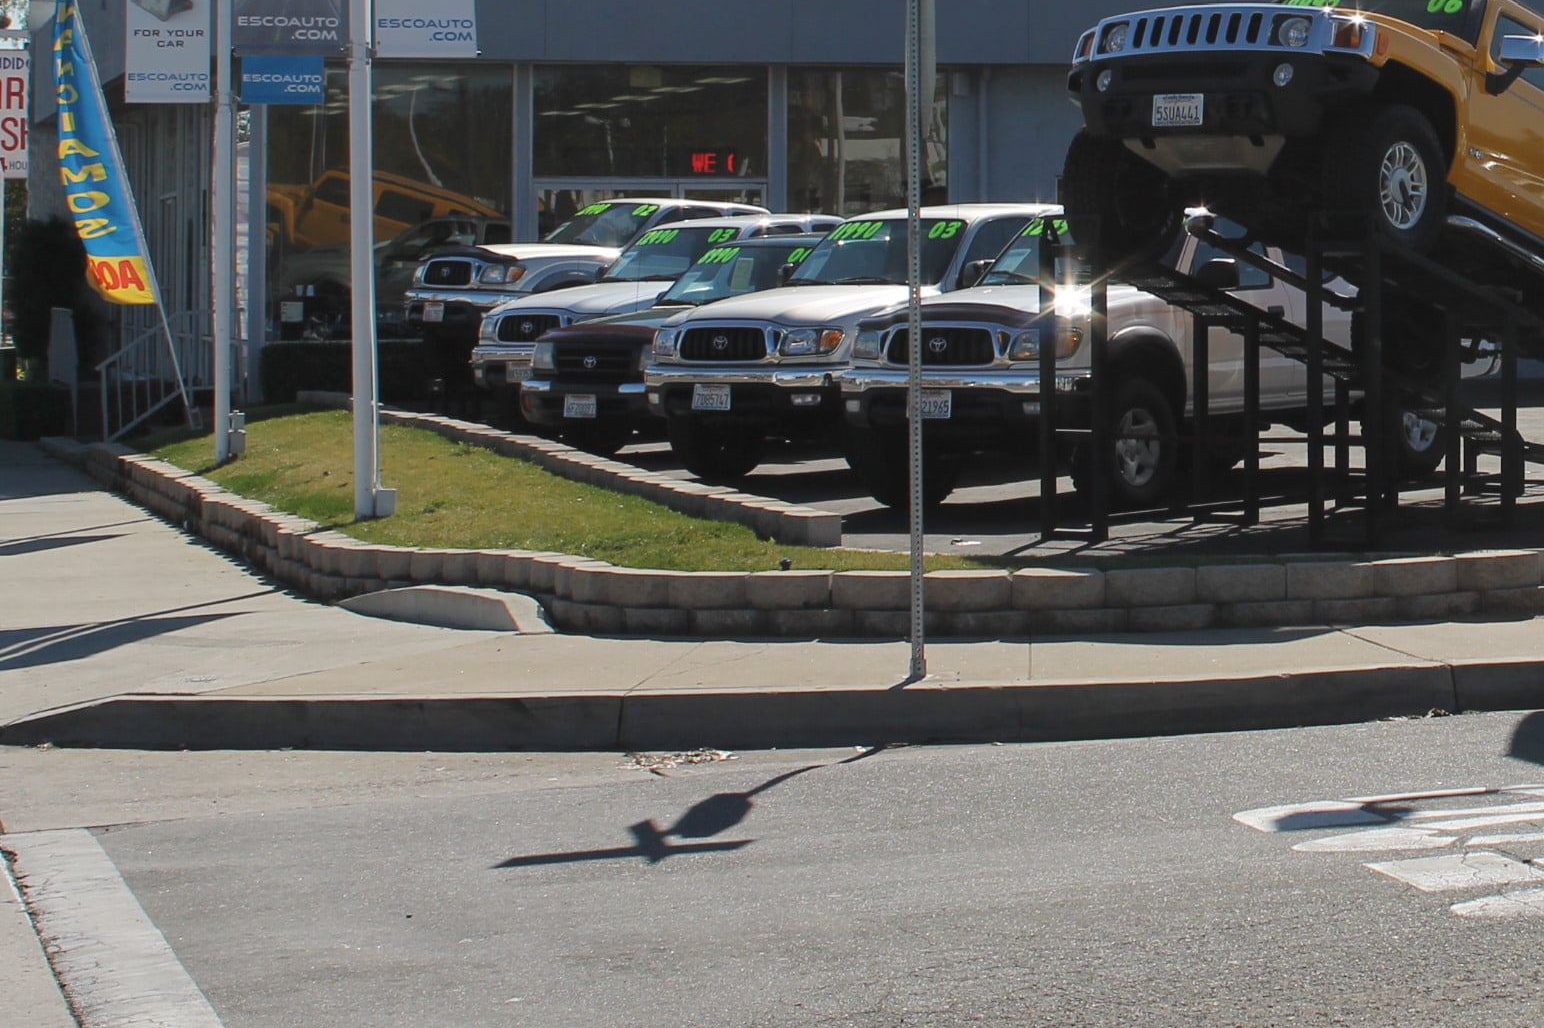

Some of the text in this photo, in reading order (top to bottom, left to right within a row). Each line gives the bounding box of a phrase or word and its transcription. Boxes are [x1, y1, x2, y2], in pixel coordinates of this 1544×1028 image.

[238, 16, 339, 28] ESCOAUTO
[378, 19, 473, 29] ESCOAUTO
[134, 29, 204, 37] FOR YOUR
[291, 30, 338, 40] .COM
[429, 32, 472, 41] .COM
[157, 40, 184, 48] CAR
[128, 73, 208, 82] ESCOAUTO
[242, 74, 322, 84] ESCOAUTO
[170, 83, 208, 91] .COM
[284, 84, 320, 93] .COM
[1156, 104, 1201, 121] 5SUA441
[692, 153, 716, 172] WE
[632, 204, 659, 216] 02
[828, 221, 961, 240] 11990 03
[707, 229, 736, 243] 03
[787, 248, 813, 262] 01
